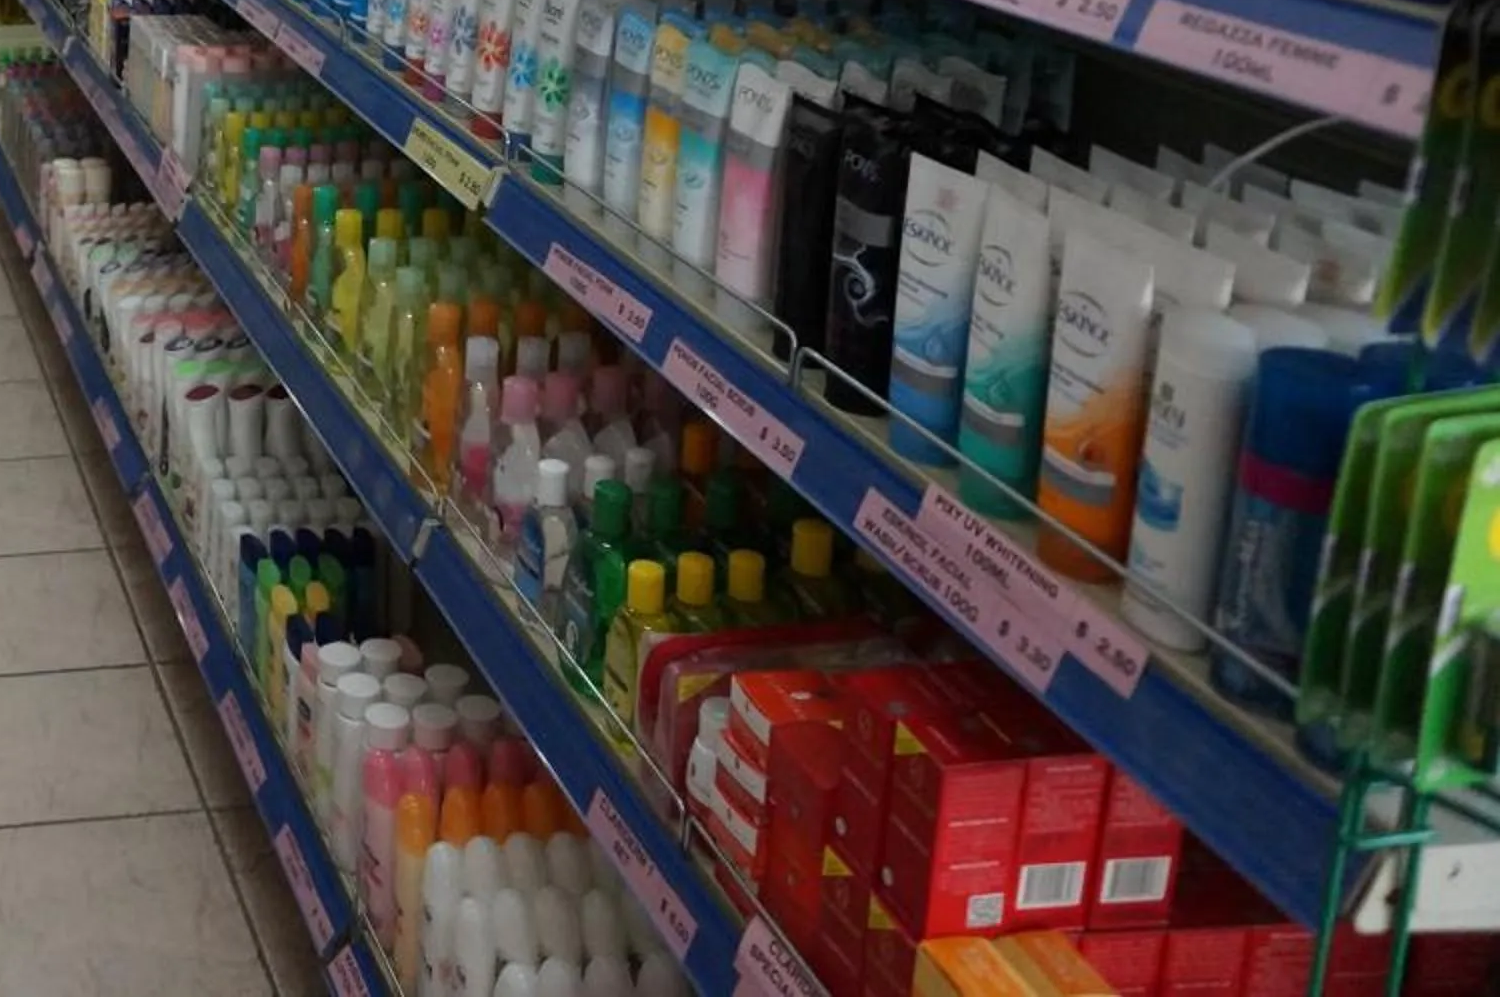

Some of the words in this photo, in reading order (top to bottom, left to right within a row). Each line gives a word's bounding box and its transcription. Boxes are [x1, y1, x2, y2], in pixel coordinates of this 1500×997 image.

[963, 510, 985, 538] UV
[984, 529, 1060, 600] WHITENING
[942, 580, 980, 624] 100G
[996, 619, 1011, 638] $
[1075, 620, 1090, 639] $
[1094, 636, 1138, 677] 2.50
